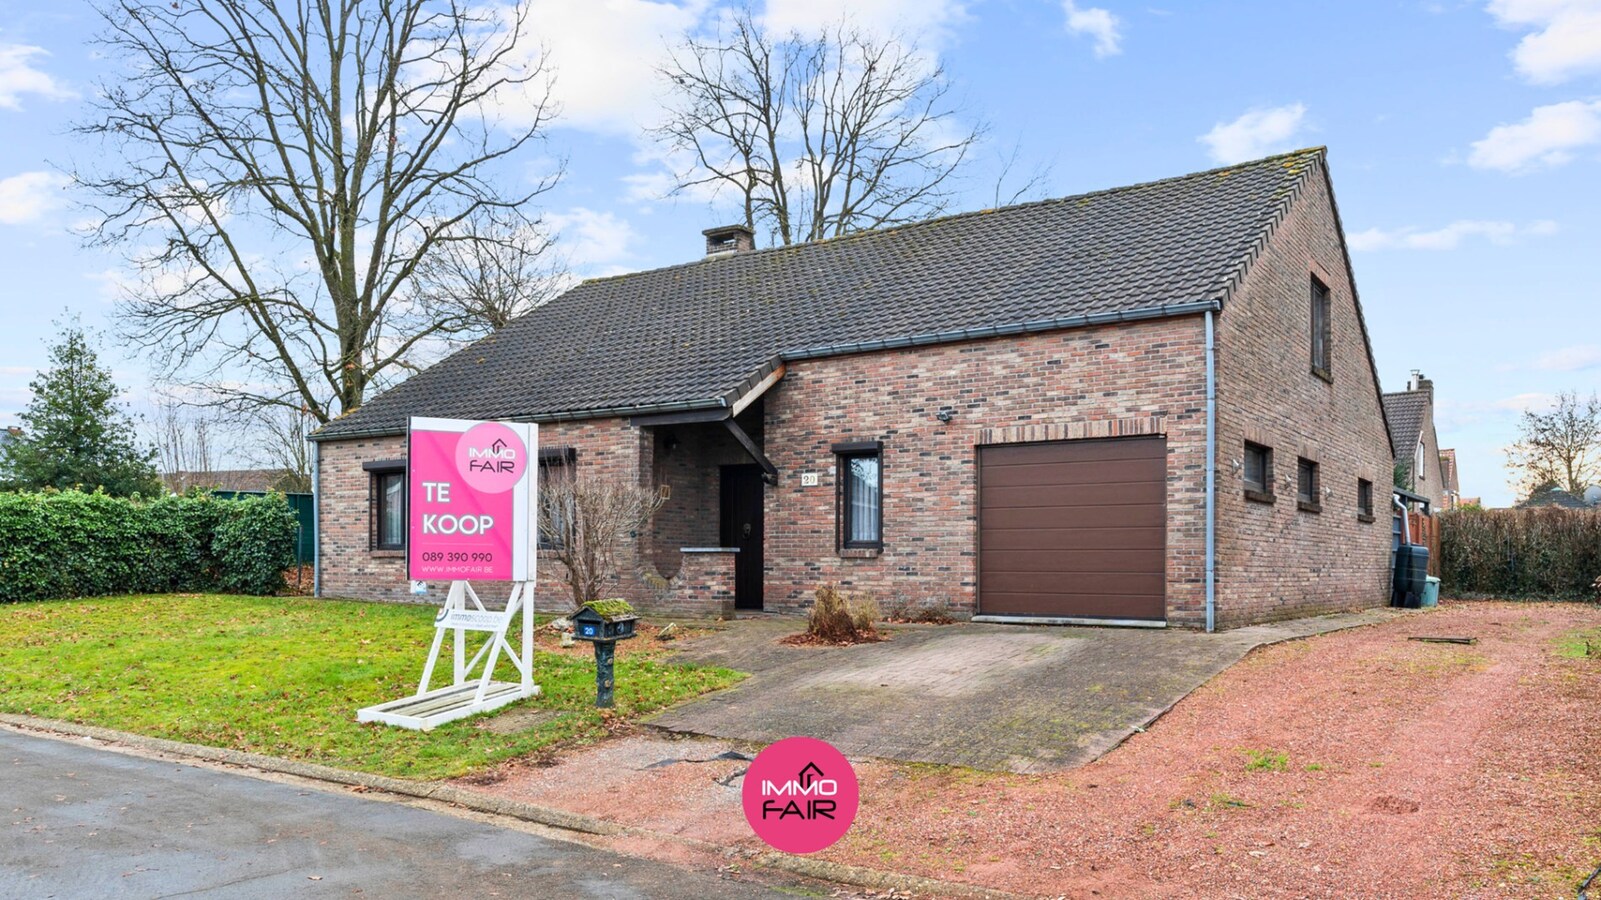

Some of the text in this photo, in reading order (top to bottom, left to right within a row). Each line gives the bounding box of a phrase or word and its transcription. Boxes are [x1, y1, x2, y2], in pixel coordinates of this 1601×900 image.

[469, 447, 516, 460] IMMO
[469, 459, 515, 473] FAIR
[803, 475, 816, 484] 20
[422, 482, 451, 502] TE
[422, 514, 494, 535] KOOP
[422, 552, 493, 562] 089 390 990
[584, 627, 594, 635] 20
